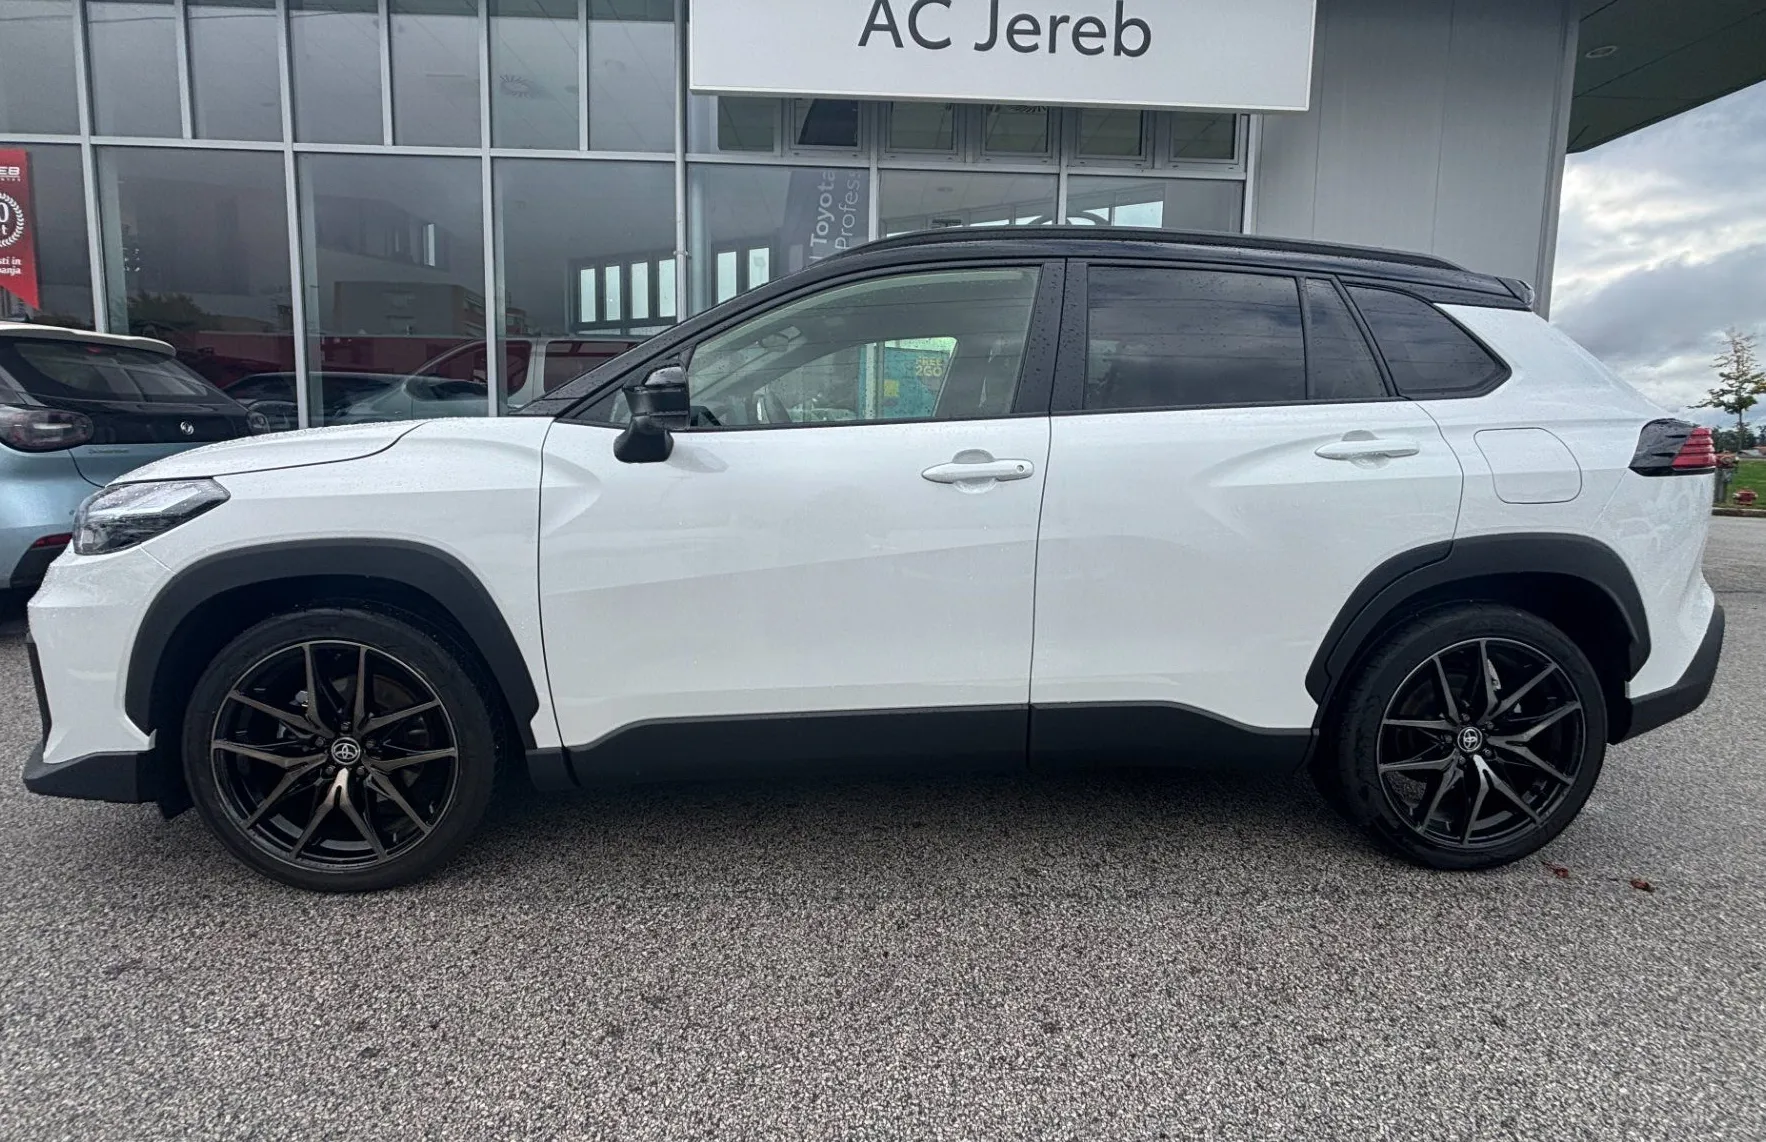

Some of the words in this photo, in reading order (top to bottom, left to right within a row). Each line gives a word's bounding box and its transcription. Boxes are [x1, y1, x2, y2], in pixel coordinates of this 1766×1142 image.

[858, 0, 951, 50] AC
[973, 0, 1152, 57] Jereb
[810, 171, 835, 247] Toyota
[0, 265, 21, 276] anja
